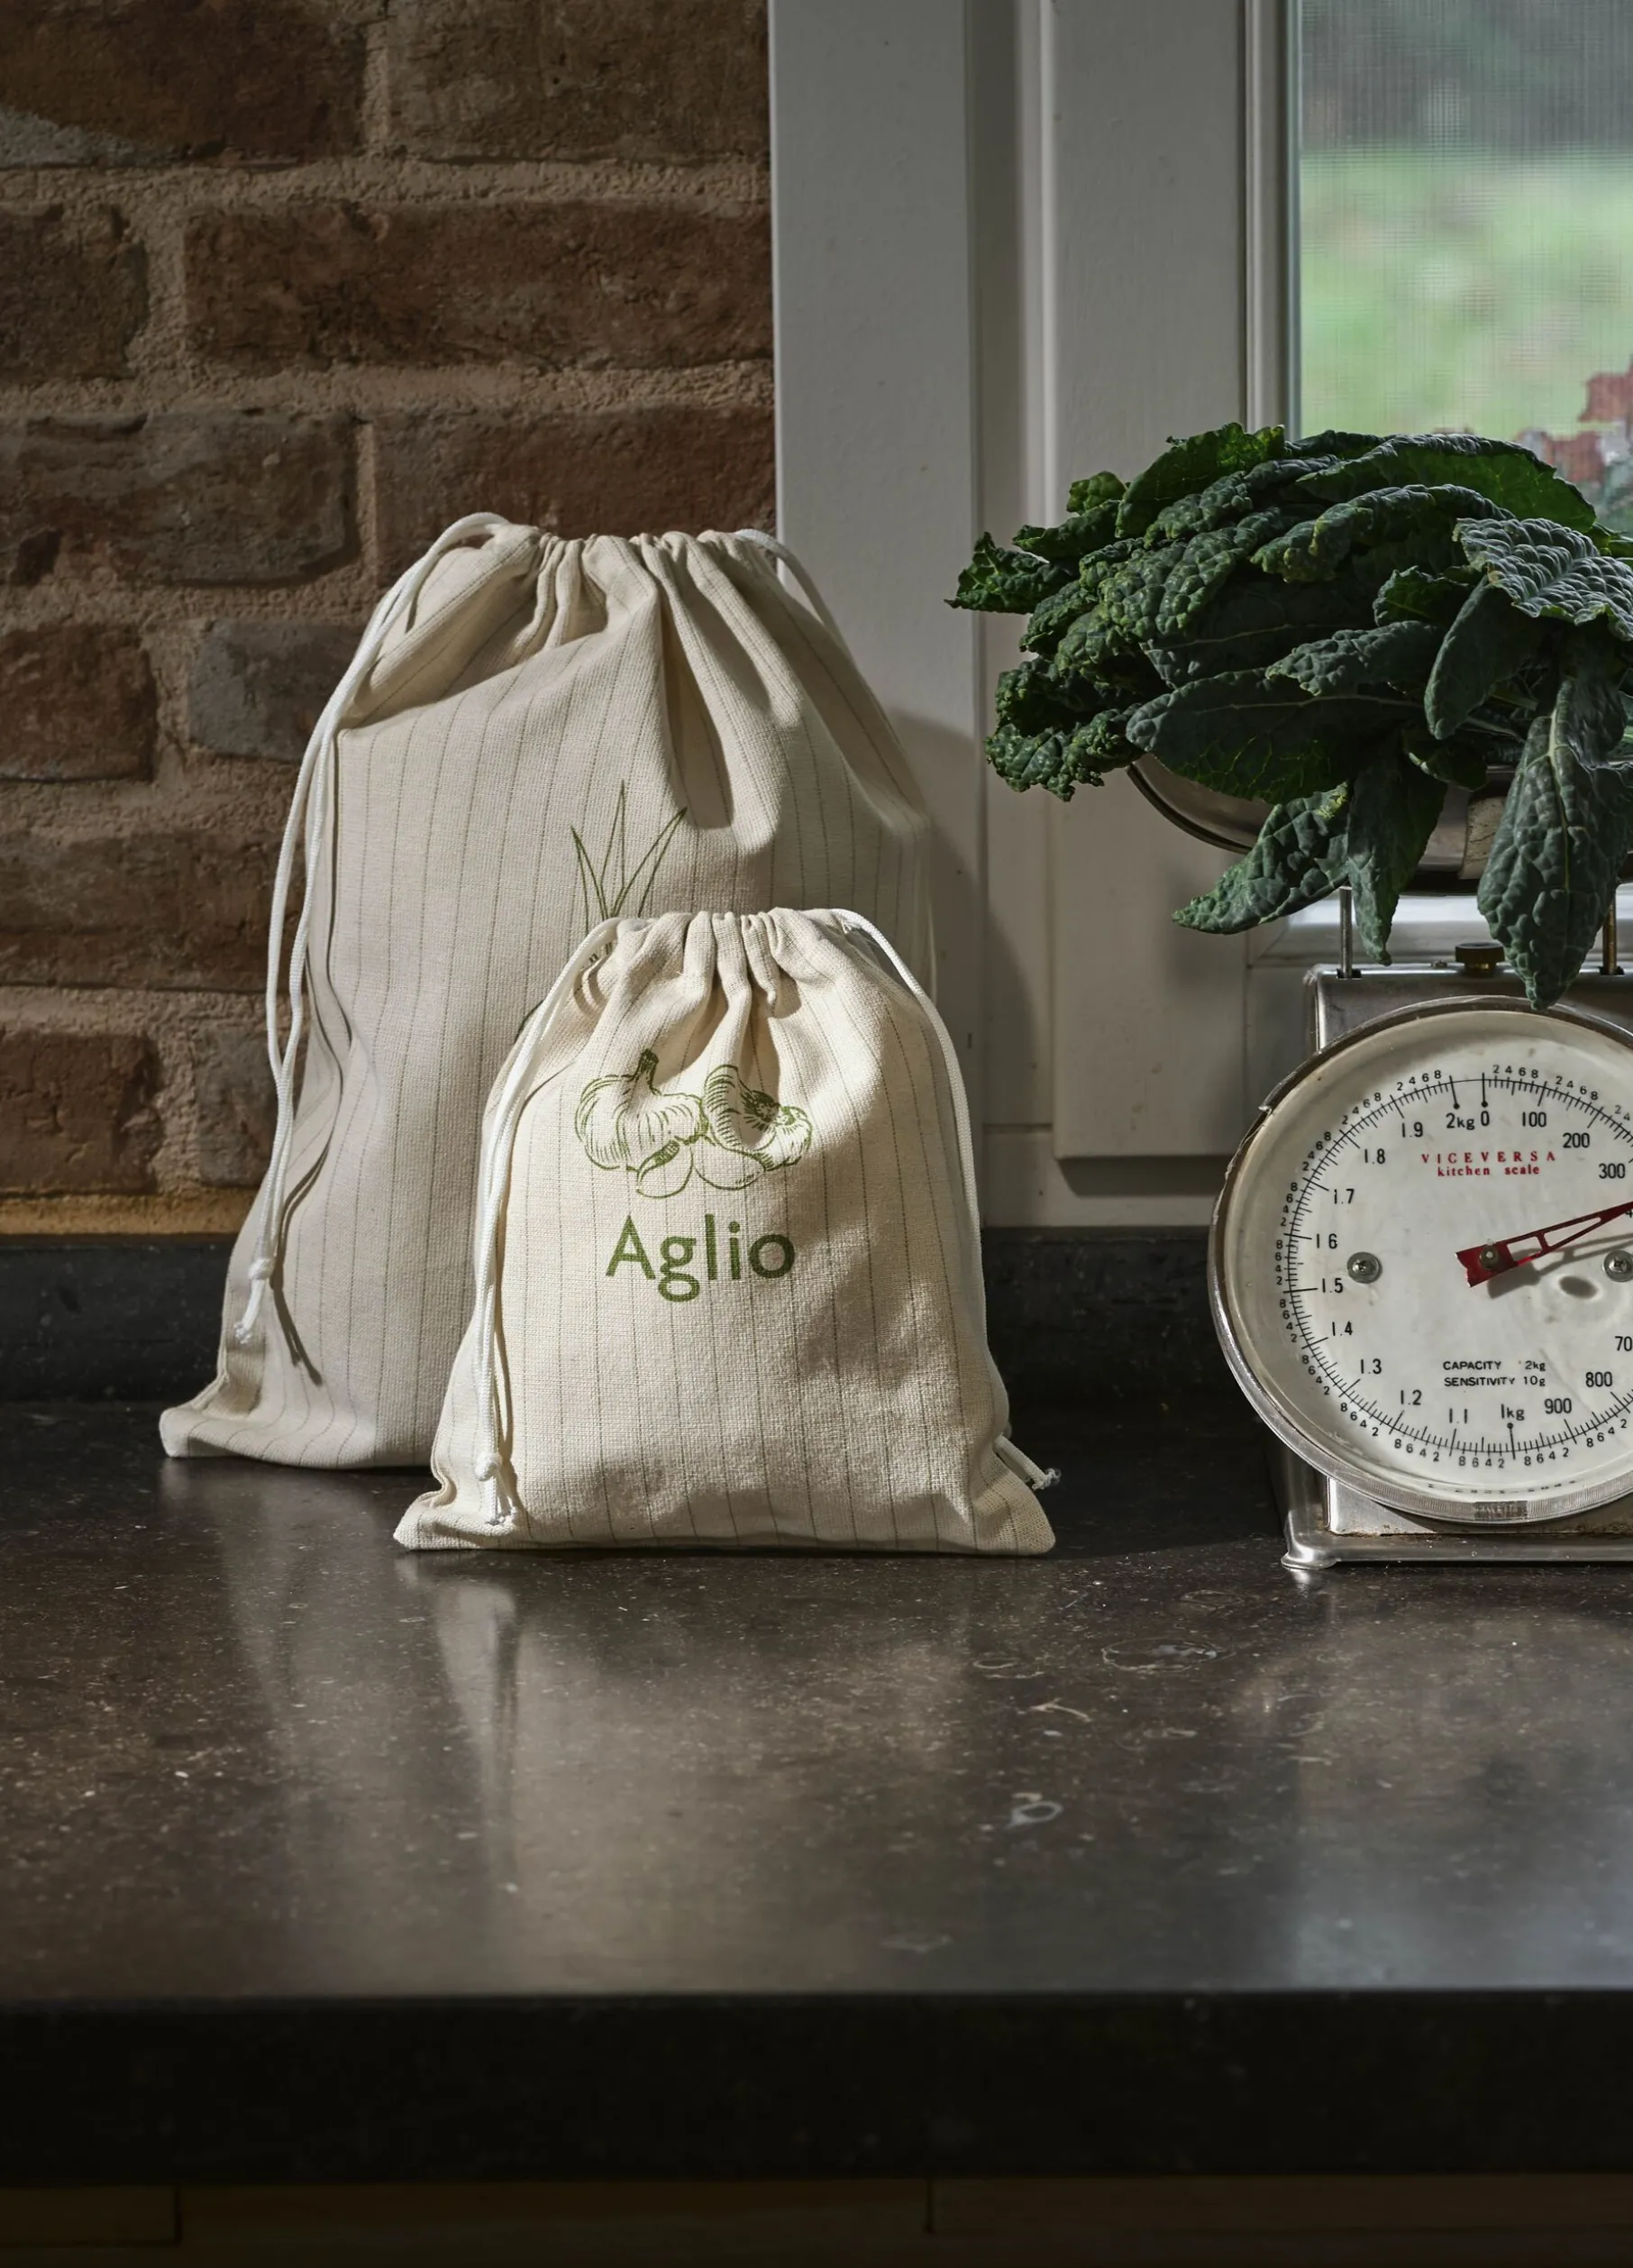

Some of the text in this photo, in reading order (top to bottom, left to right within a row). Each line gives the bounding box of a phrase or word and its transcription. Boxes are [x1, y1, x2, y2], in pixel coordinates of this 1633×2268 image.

[1446, 1112, 1475, 1130] 2kg
[1480, 1111, 1491, 1127] 0
[1521, 1111, 1547, 1128] 100
[1401, 1121, 1424, 1138] 1.9
[1562, 1132, 1591, 1148] 200
[1364, 1148, 1386, 1164] 1.8
[1421, 1151, 1555, 1164] VICEVERSA
[1437, 1164, 1540, 1176] kitchen scale
[1598, 1163, 1626, 1179] 300
[1334, 1188, 1355, 1204] 1.7
[606, 1213, 797, 1303] Aglio
[1322, 1278, 1344, 1294] 1.5
[1332, 1321, 1353, 1336] 1.4
[1361, 1358, 1382, 1374] 1.3
[1443, 1360, 1546, 1371] CAPACITY 2kg
[1444, 1376, 1546, 1386] SENSITIVITY 10g
[1585, 1371, 1613, 1387] 800
[1400, 1389, 1422, 1405] 1.2
[1544, 1398, 1573, 1414] 900
[1449, 1408, 1468, 1424] 1.1
